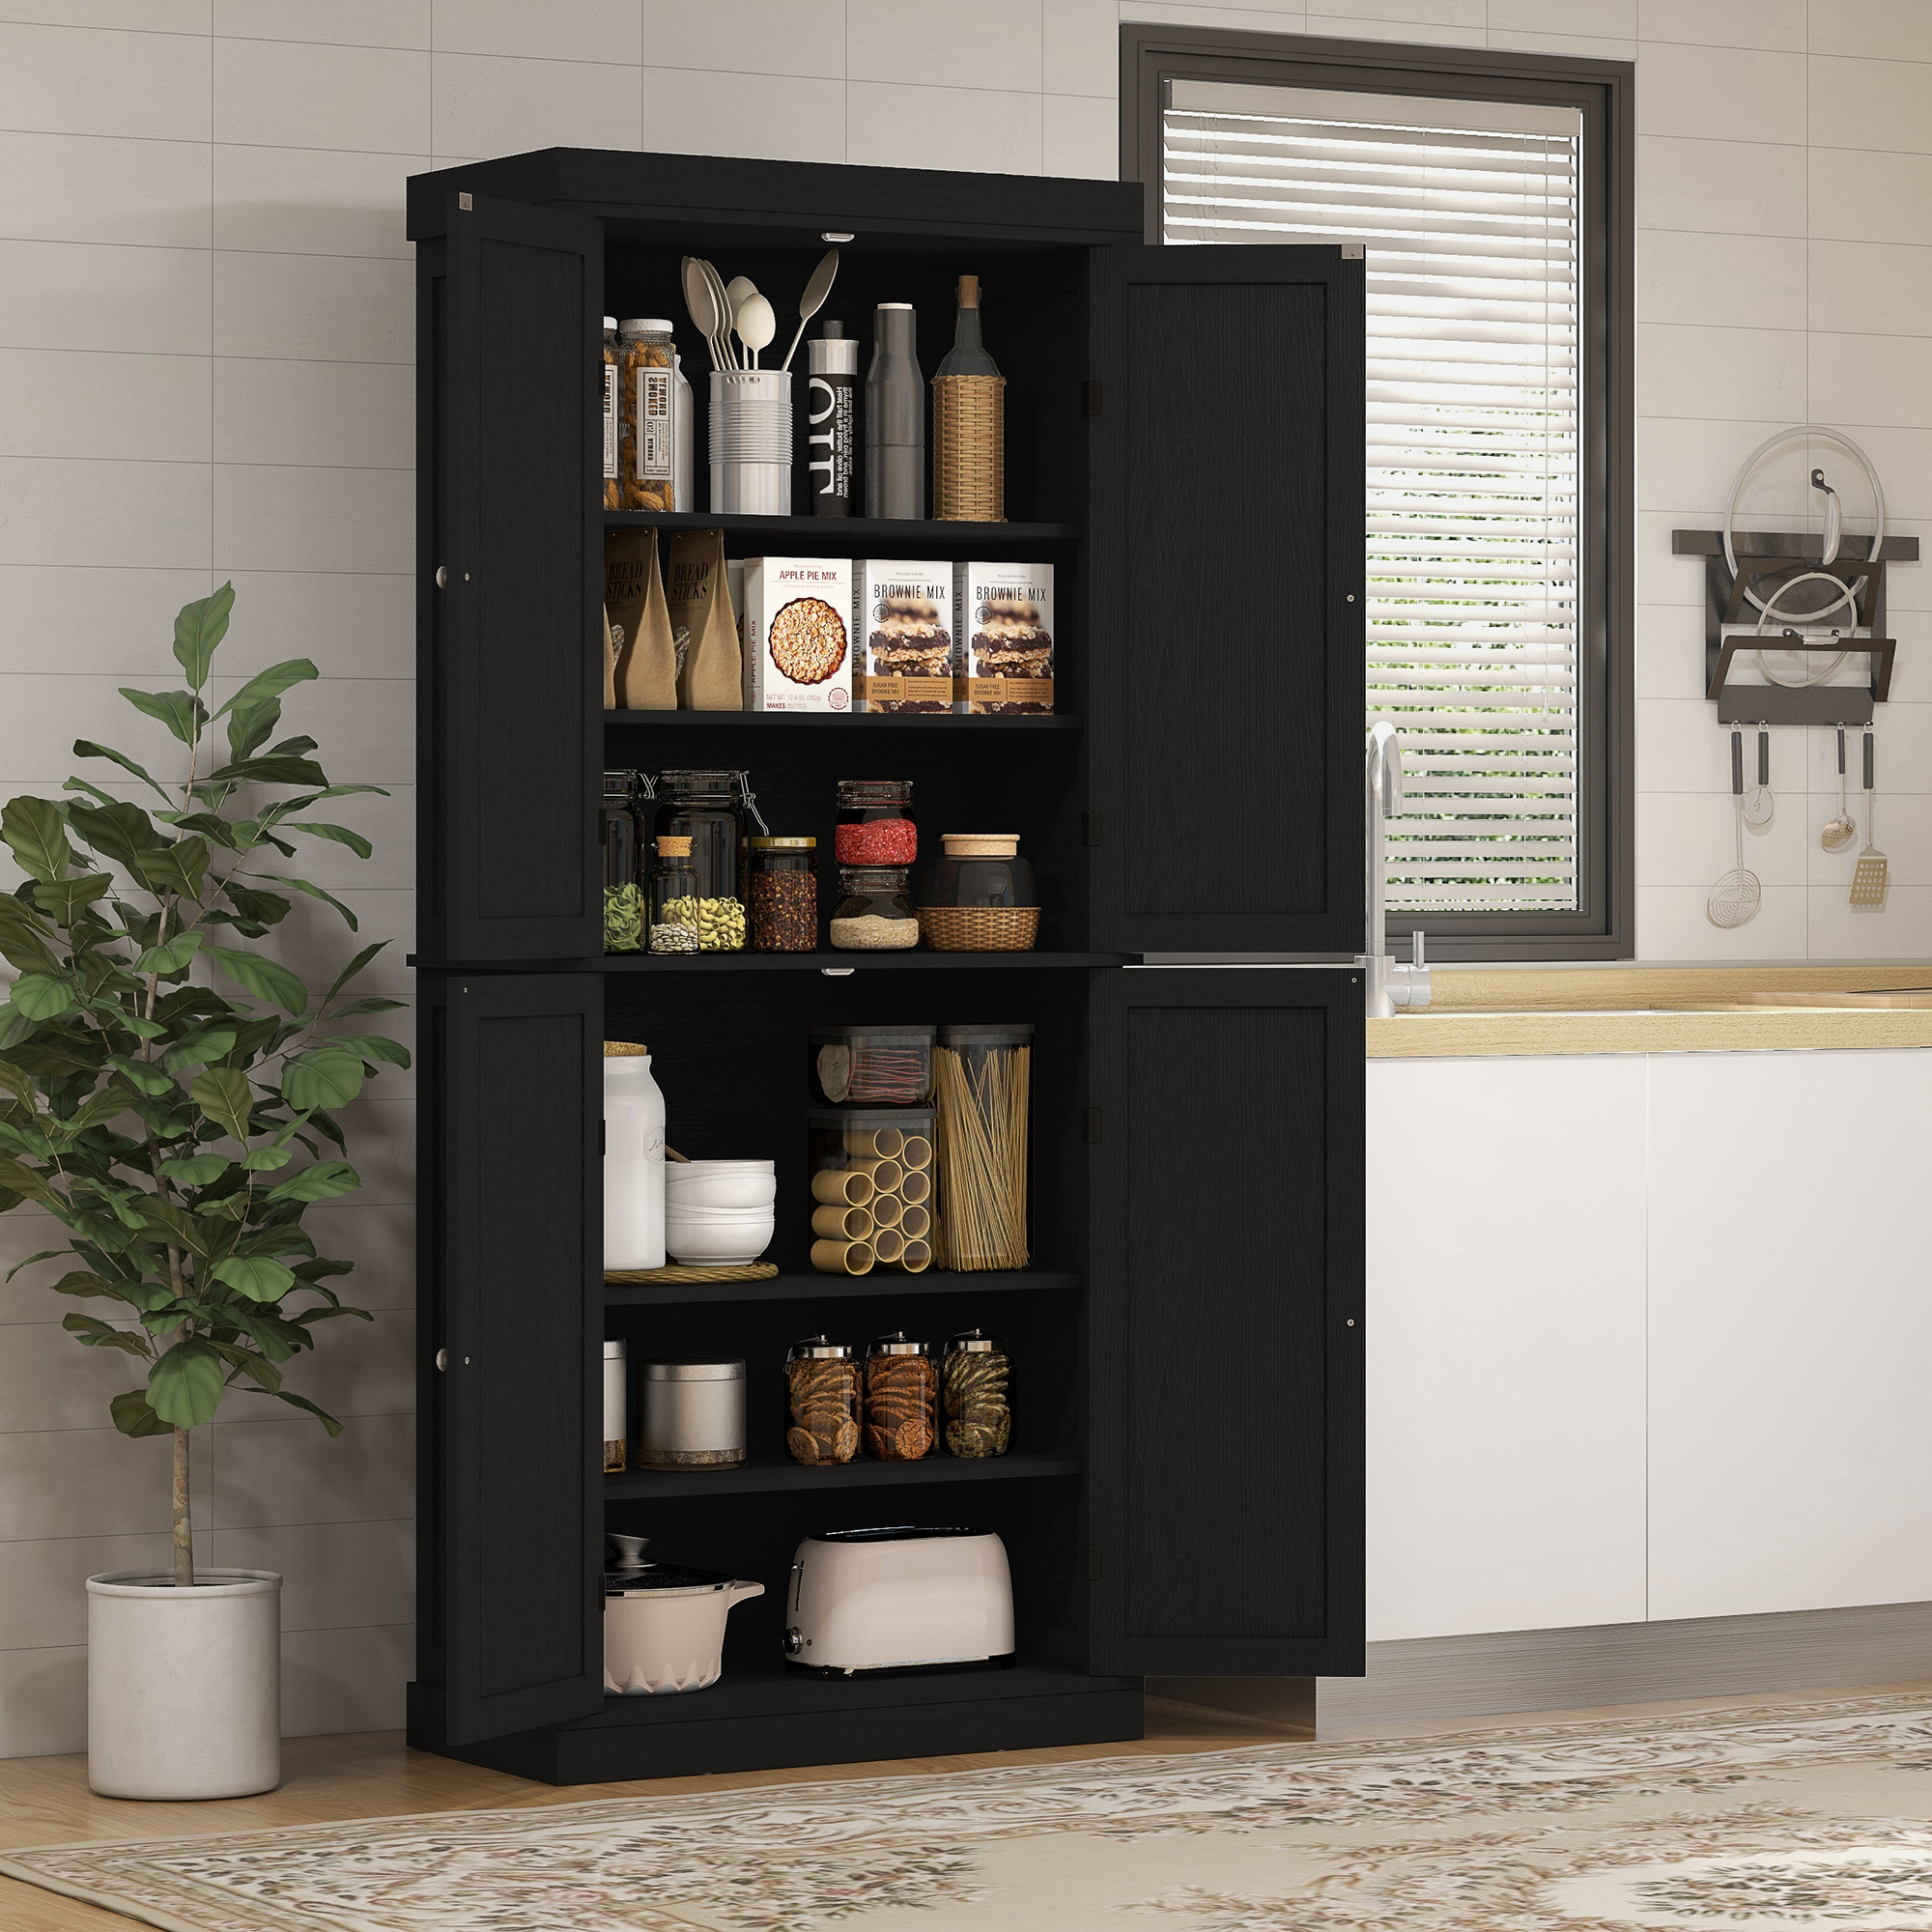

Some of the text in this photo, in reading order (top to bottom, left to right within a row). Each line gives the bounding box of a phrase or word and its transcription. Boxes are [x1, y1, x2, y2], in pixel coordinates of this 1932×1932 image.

[609, 561, 643, 580] BREAD
[674, 562, 708, 582] BREAD
[779, 571, 837, 580] APPLE PIE MIX
[607, 580, 641, 599] STICKS
[672, 581, 707, 600] STICKS
[874, 584, 945, 599] BROWNIE MIX
[976, 586, 1046, 601] BROWNIE MIX
